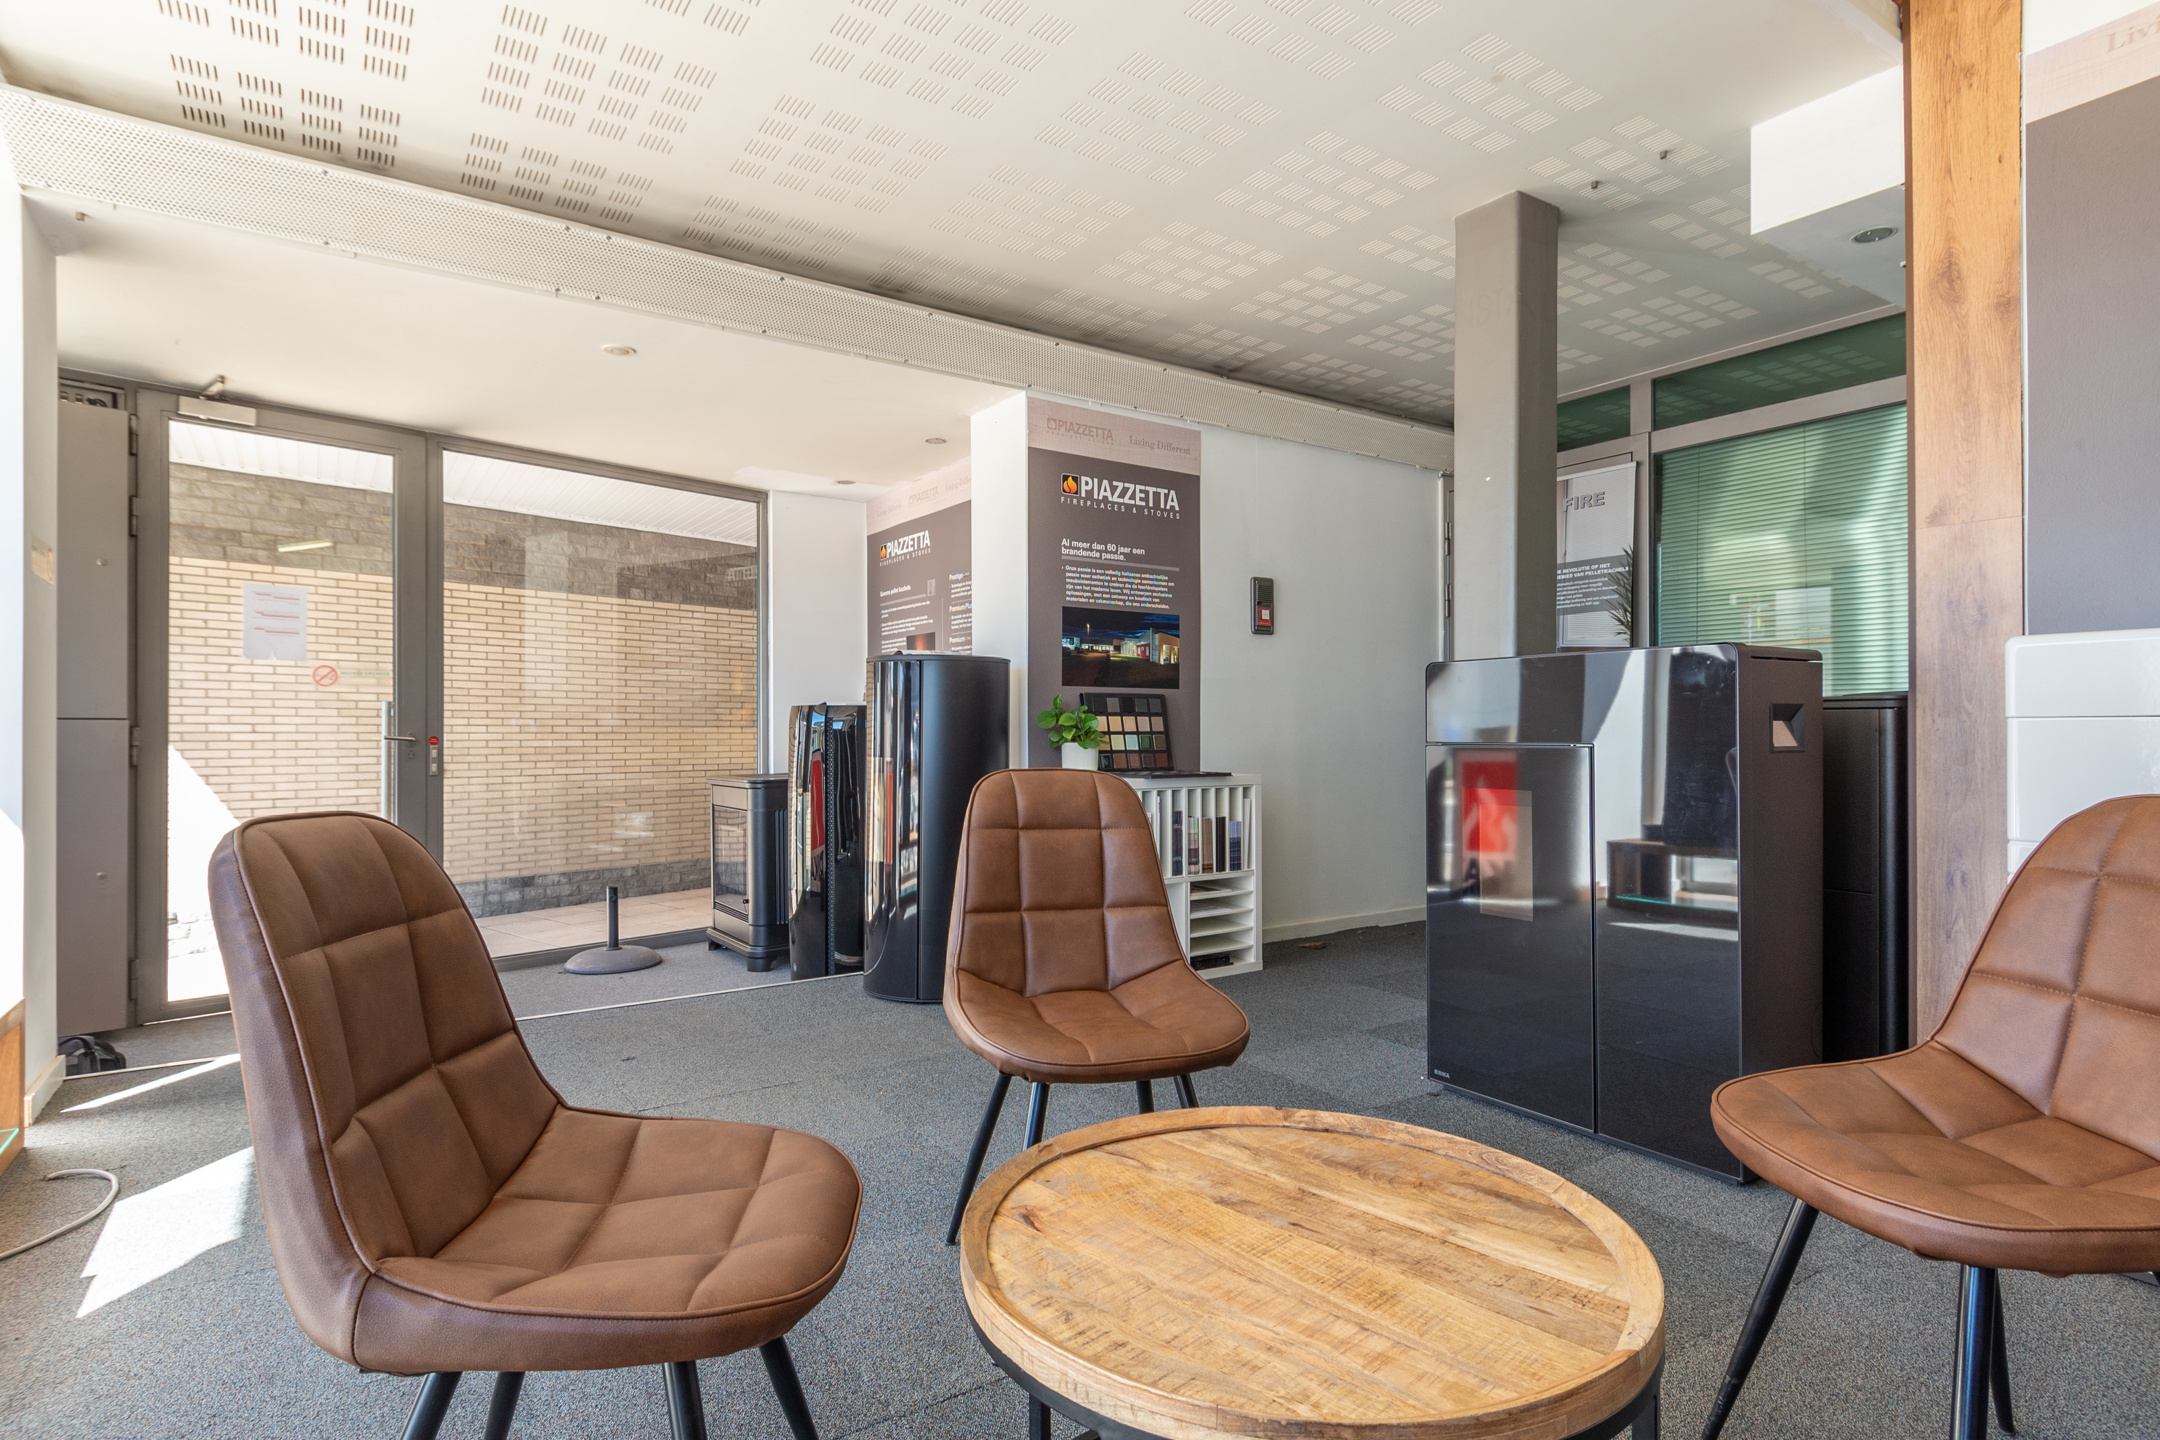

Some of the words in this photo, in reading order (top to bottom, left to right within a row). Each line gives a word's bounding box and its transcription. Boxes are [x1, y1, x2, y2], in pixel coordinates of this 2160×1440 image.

[1057, 419, 1114, 441] PIAZZETTA
[1129, 435, 1155, 450] Living
[1157, 440, 1191, 455] Different
[1081, 475, 1180, 511] PIAZZETTA
[1563, 491, 1606, 512] FIRE
[1061, 496, 1125, 513] FIREPLACES
[1132, 506, 1137, 514] &
[1144, 509, 1181, 520] STOVES
[886, 530, 931, 558] PIAZZETTA
[1061, 538, 1070, 546] Al
[1071, 541, 1090, 549] meer
[1092, 542, 1105, 550] dan
[1107, 543, 1116, 552] 60
[1117, 544, 1131, 555] jaar
[1061, 546, 1100, 558] brandende
